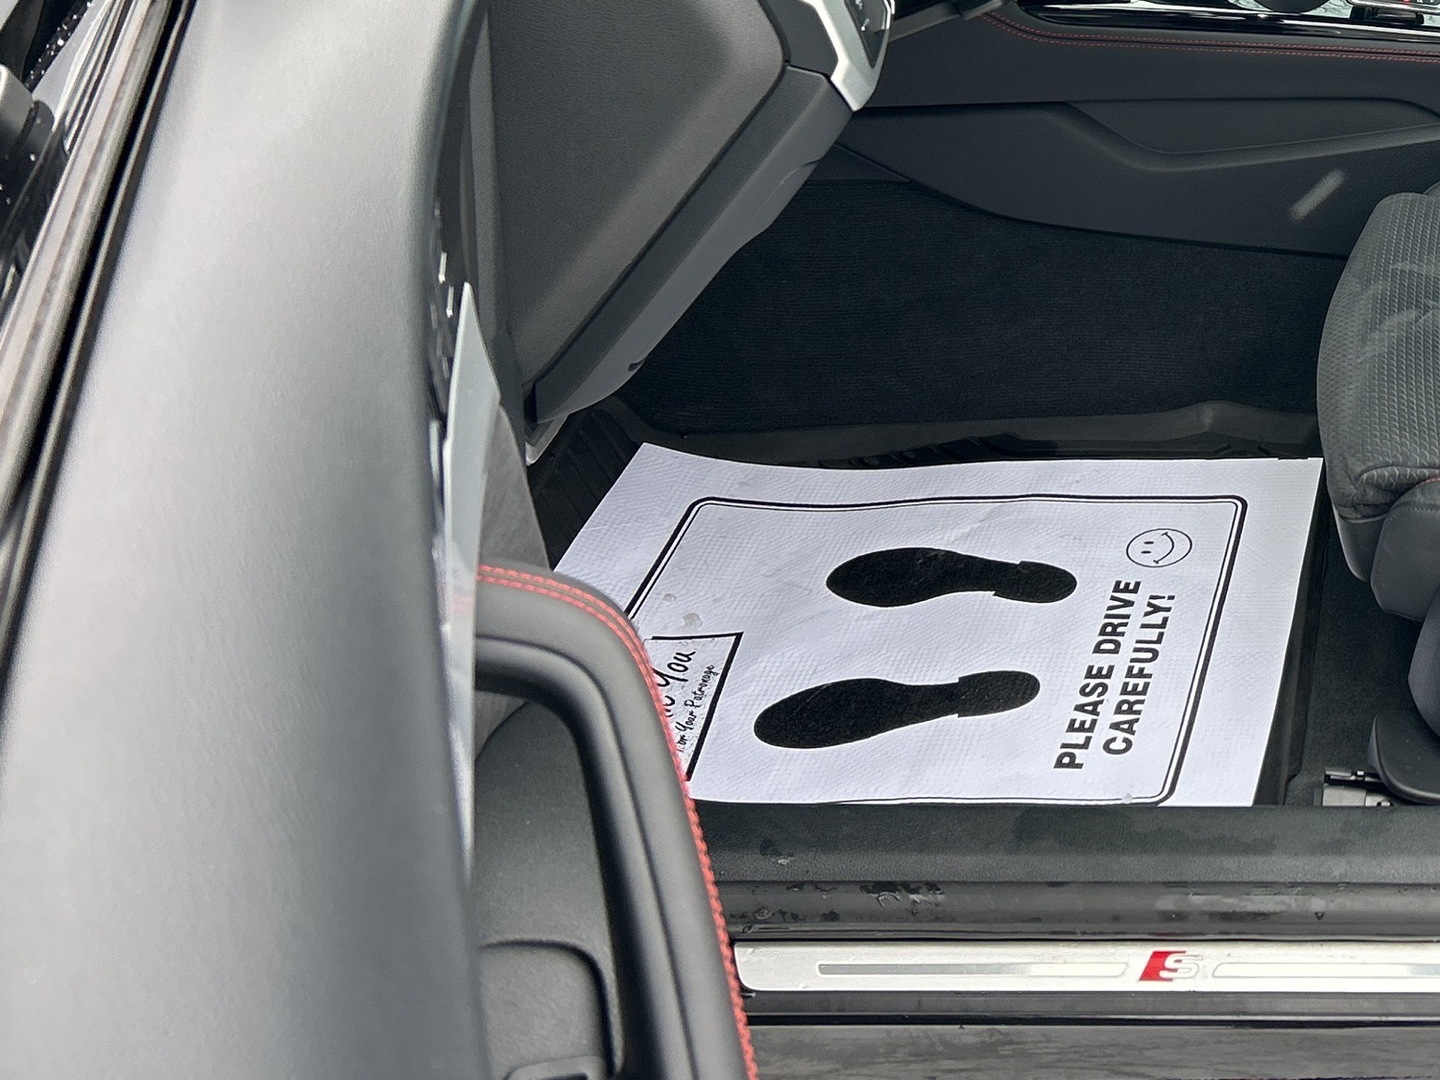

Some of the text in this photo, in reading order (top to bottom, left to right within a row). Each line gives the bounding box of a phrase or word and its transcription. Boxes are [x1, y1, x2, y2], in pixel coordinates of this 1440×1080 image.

[652, 651, 696, 688] You
[684, 665, 720, 708] Patronage
[1054, 580, 1141, 769] PLEASE DRIVE
[1102, 595, 1176, 755] CAREFULLY!
